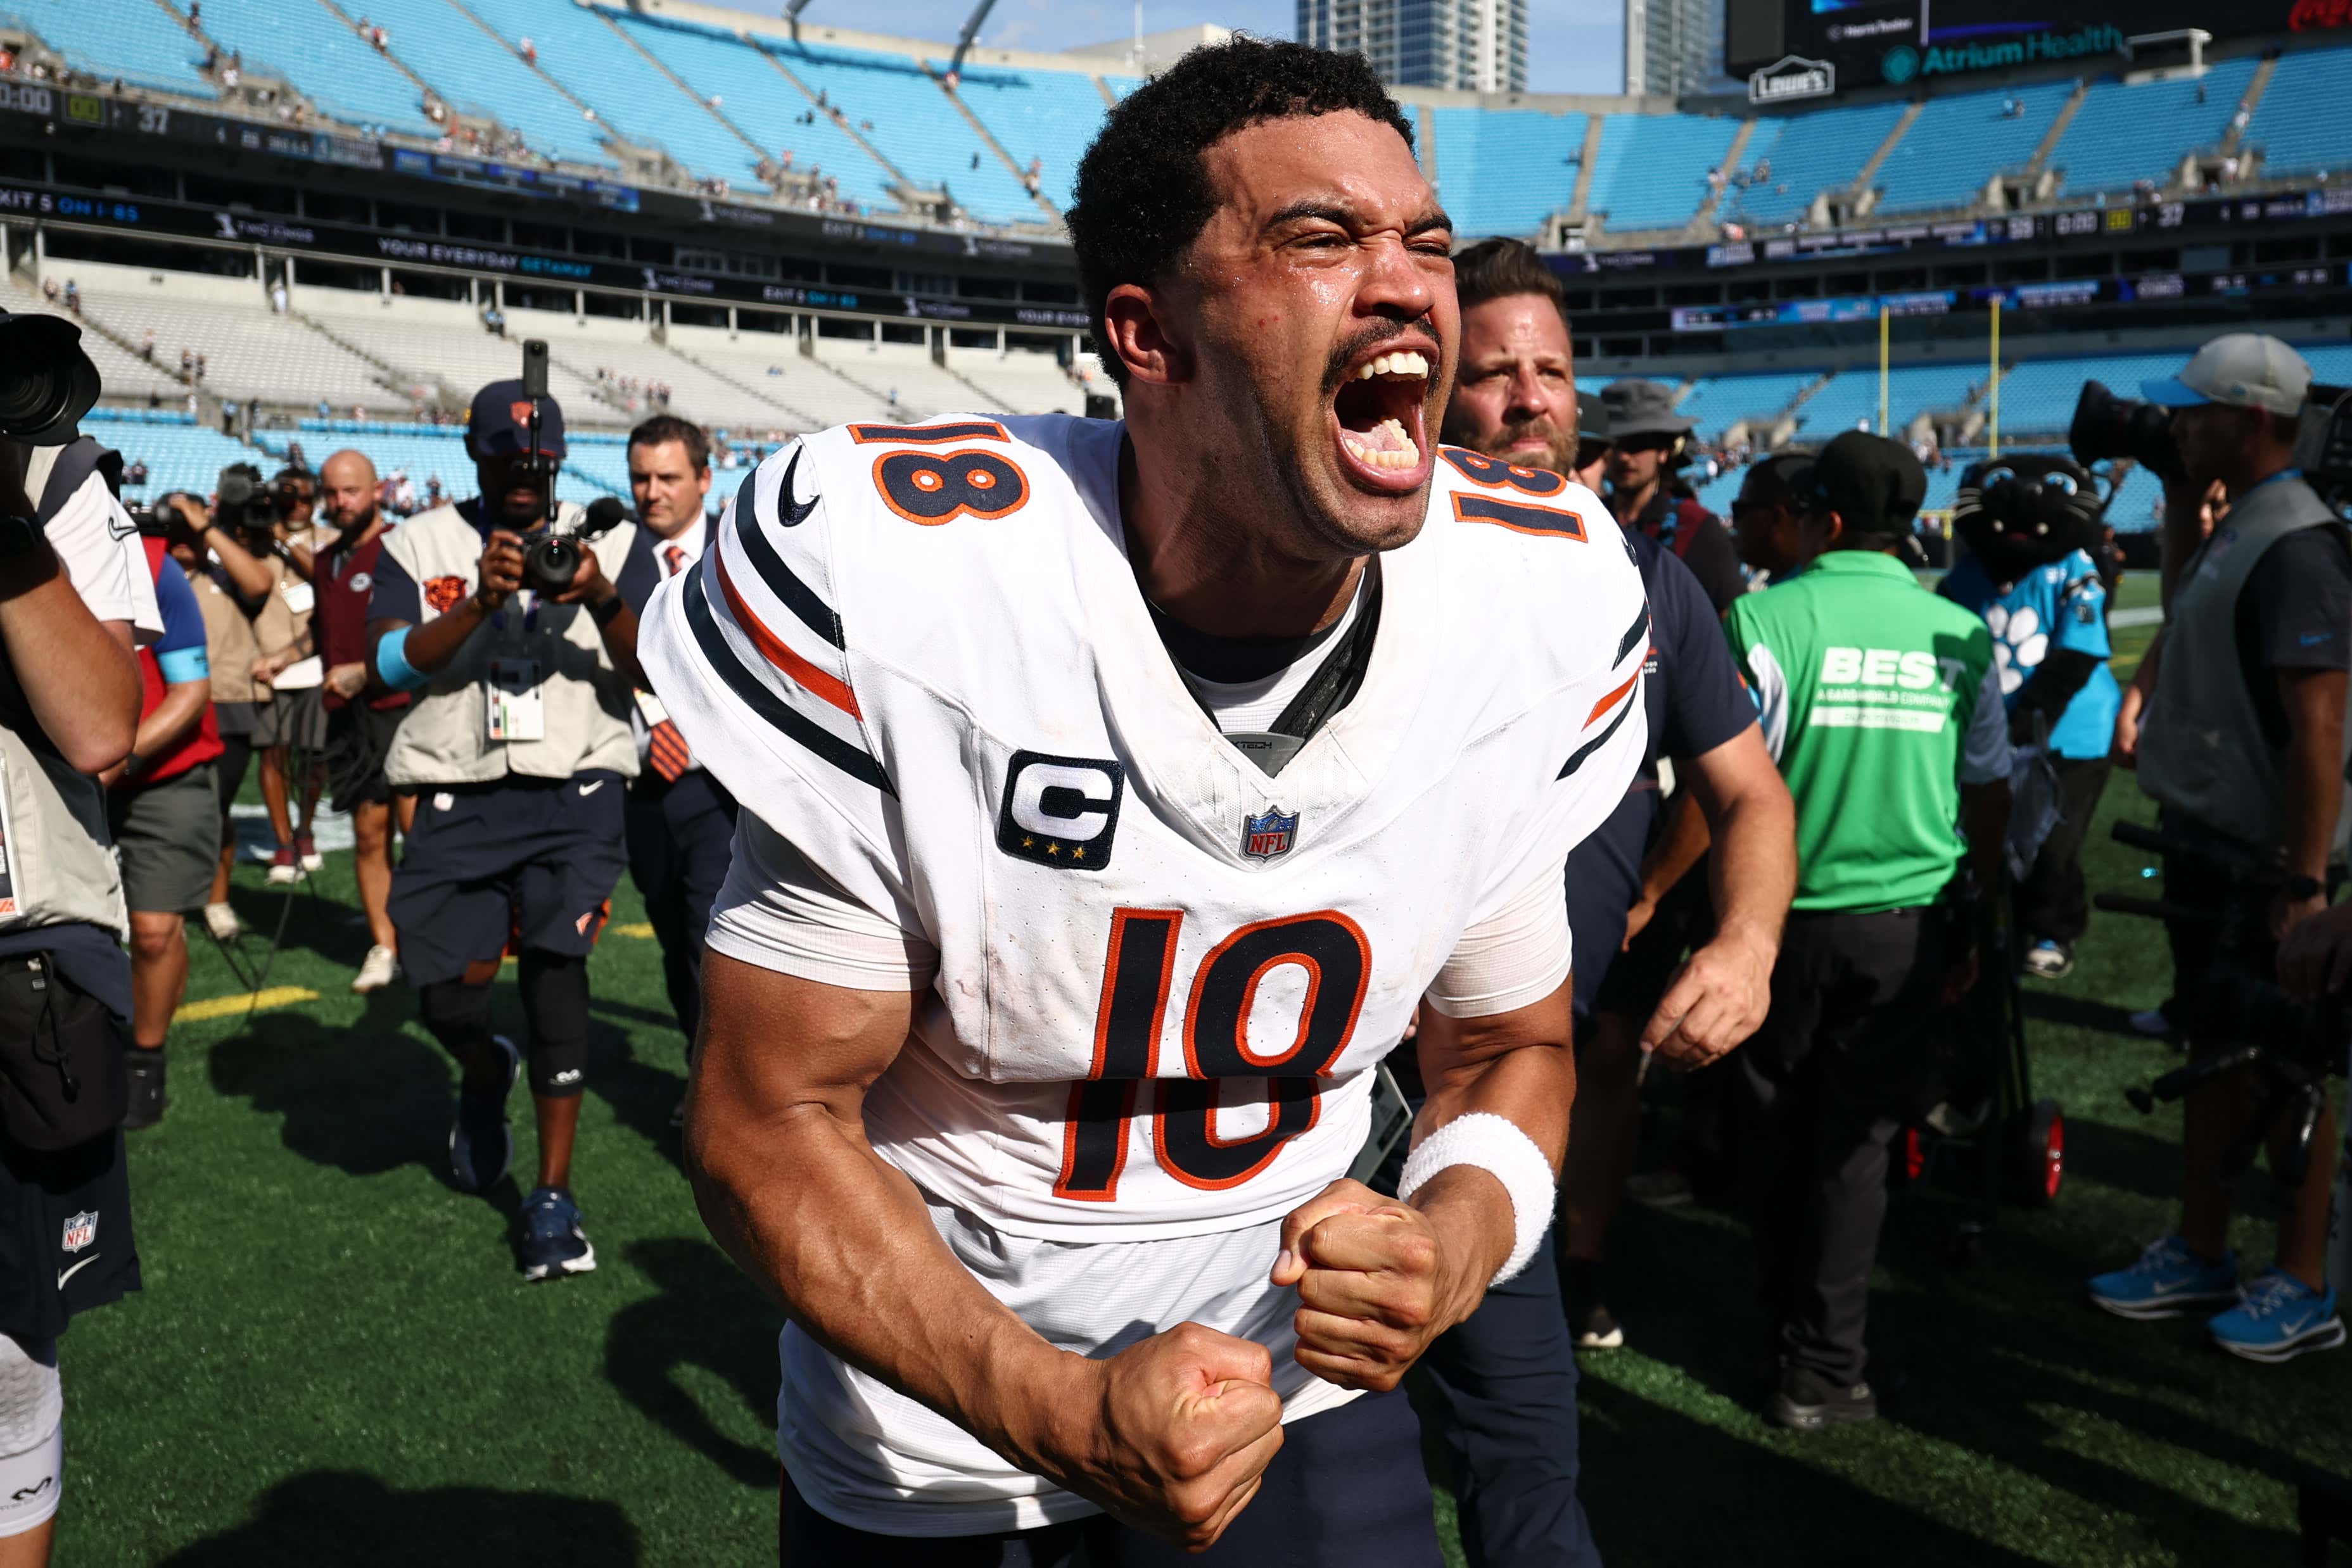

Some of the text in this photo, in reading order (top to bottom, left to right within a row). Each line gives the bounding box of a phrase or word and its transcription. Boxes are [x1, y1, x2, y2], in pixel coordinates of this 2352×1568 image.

[1923, 24, 2123, 76] Atrium Health
[137, 104, 169, 135] 37
[58, 197, 91, 216] ON
[378, 238, 592, 277] YOUR EVERYDAY GETAWAY
[846, 422, 1030, 526] 18
[1436, 446, 1589, 544] 18
[1821, 647, 1966, 692] BEST
[1011, 763, 1113, 841] C
[1249, 833, 1287, 854] NFL
[66, 1227, 91, 1246] NFL
